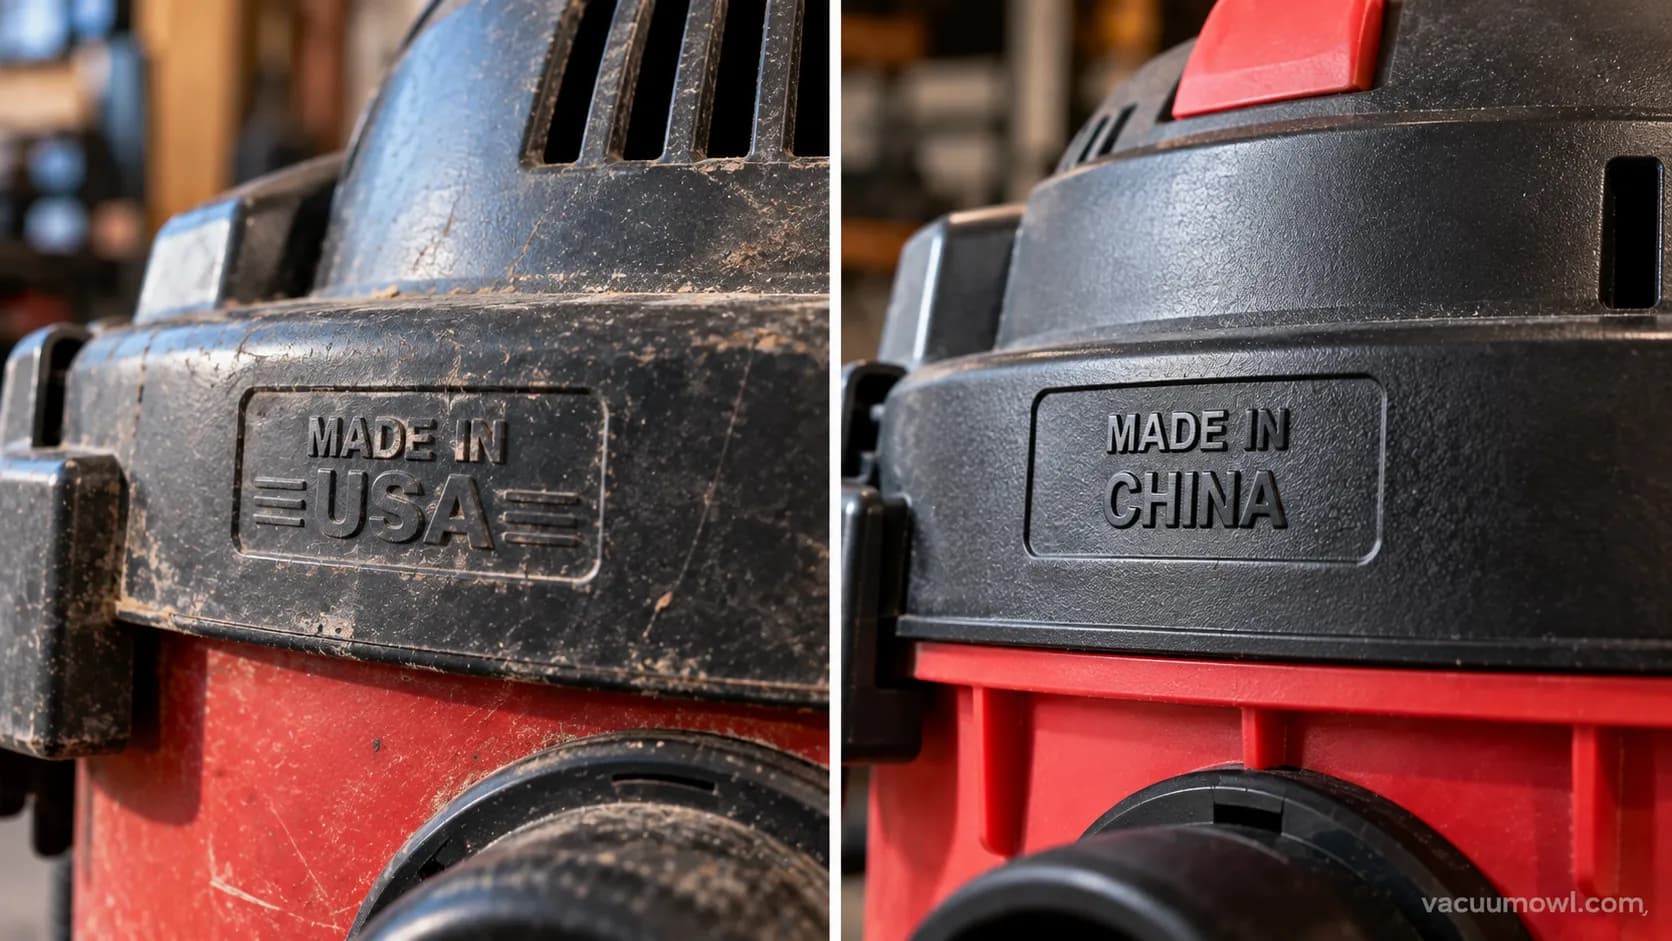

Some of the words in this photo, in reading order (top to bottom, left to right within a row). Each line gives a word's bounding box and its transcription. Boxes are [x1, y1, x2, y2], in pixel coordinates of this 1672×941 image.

[308, 416, 437, 461] MADE
[455, 418, 507, 464] IN
[1106, 409, 1229, 454] MADE
[1245, 408, 1289, 452] IN
[315, 468, 495, 550] USA
[1103, 470, 1288, 529] CHINA
